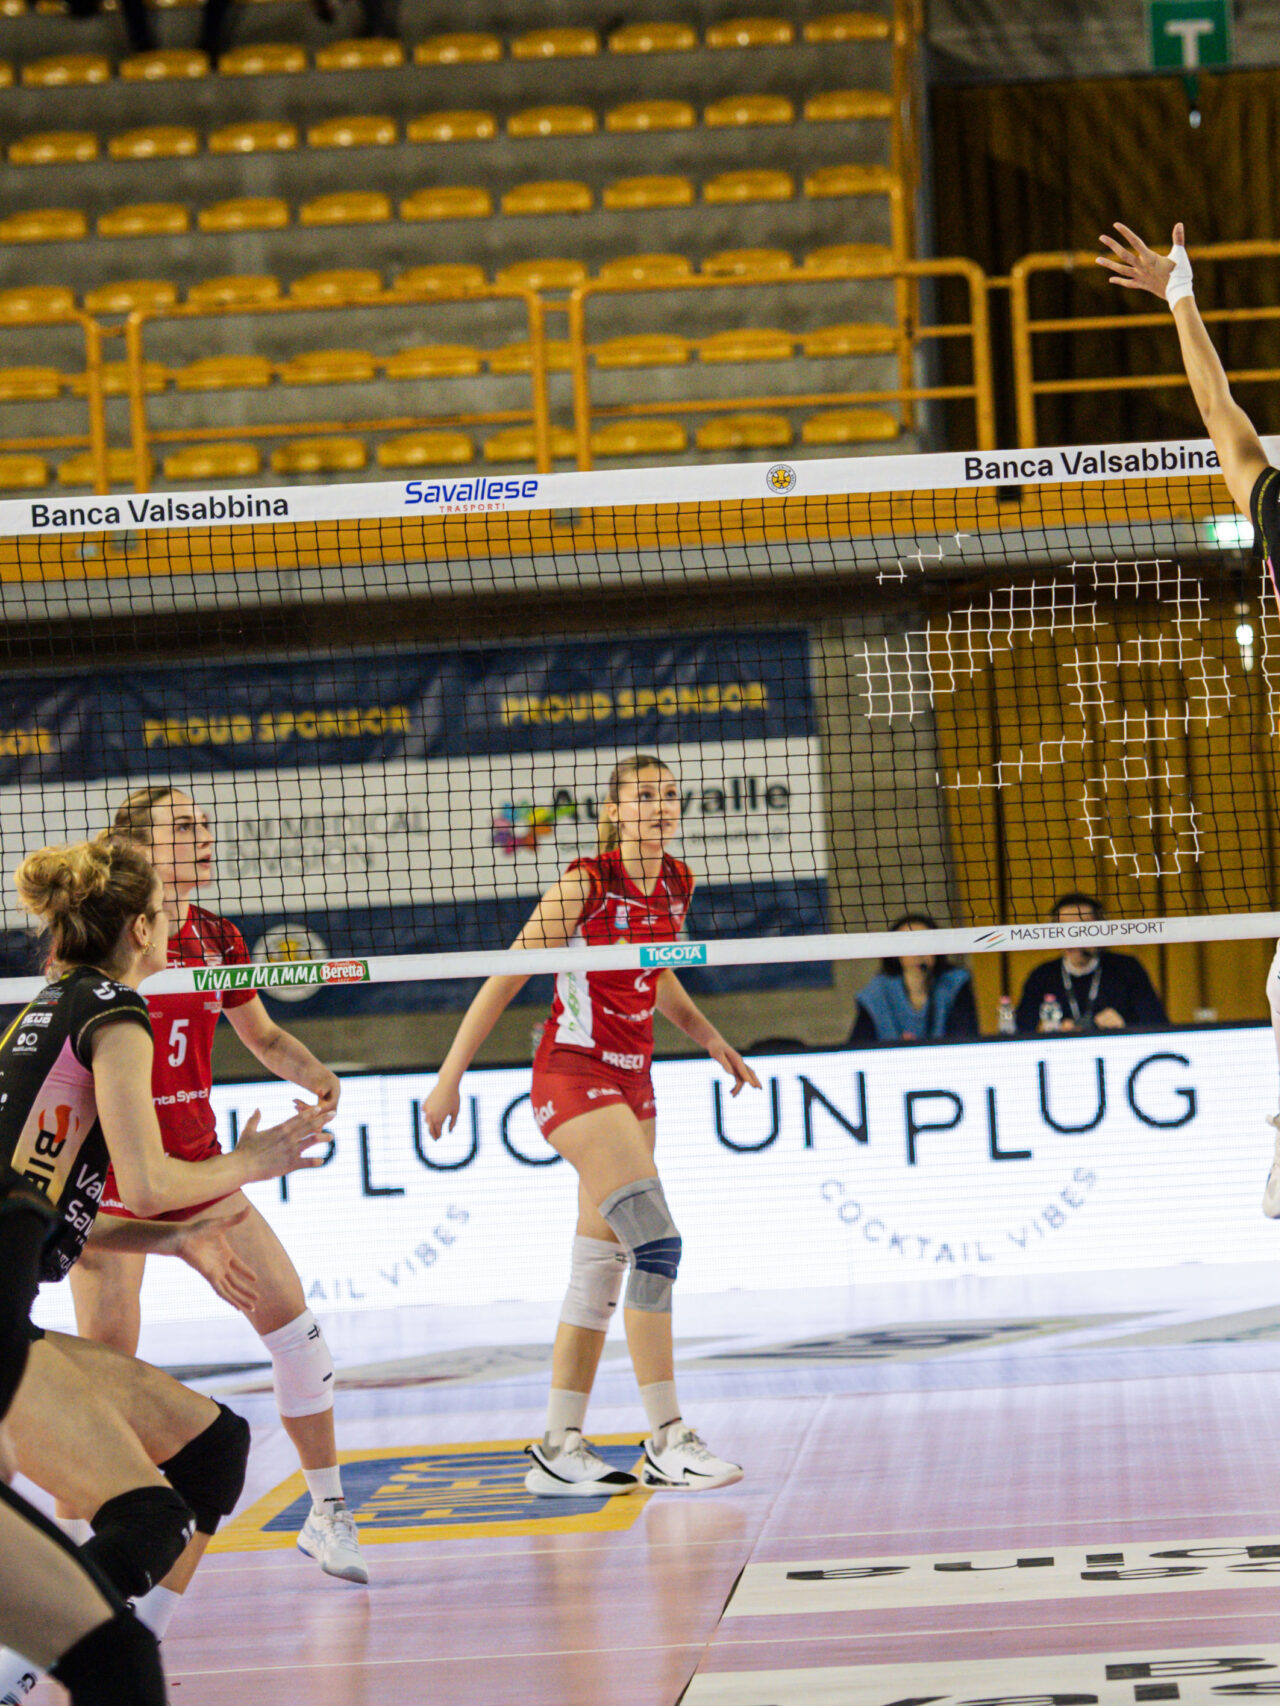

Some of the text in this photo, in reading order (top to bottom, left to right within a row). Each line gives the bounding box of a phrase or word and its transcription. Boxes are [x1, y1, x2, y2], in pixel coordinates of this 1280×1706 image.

[965, 443, 1221, 481] Banca Valsabbina
[405, 479, 538, 504] Savallese
[440, 503, 506, 513] TRASPORTI
[31, 496, 288, 528] Banca Valsabbina
[501, 682, 768, 725] PROUD SPONSOR
[142, 705, 411, 748] PROUD SPONSOR
[1010, 921, 1165, 941] MASTER GROUP SPORT
[235, 970, 248, 986] LA
[251, 966, 319, 988] MAMMA
[321, 964, 365, 981] Beretta
[168, 1018, 190, 1068] 5
[712, 1052, 1199, 1166] UNPLUG
[820, 1167, 1097, 1264] COCKTAIL VIBES
[377, 1203, 470, 1287] VIBES
